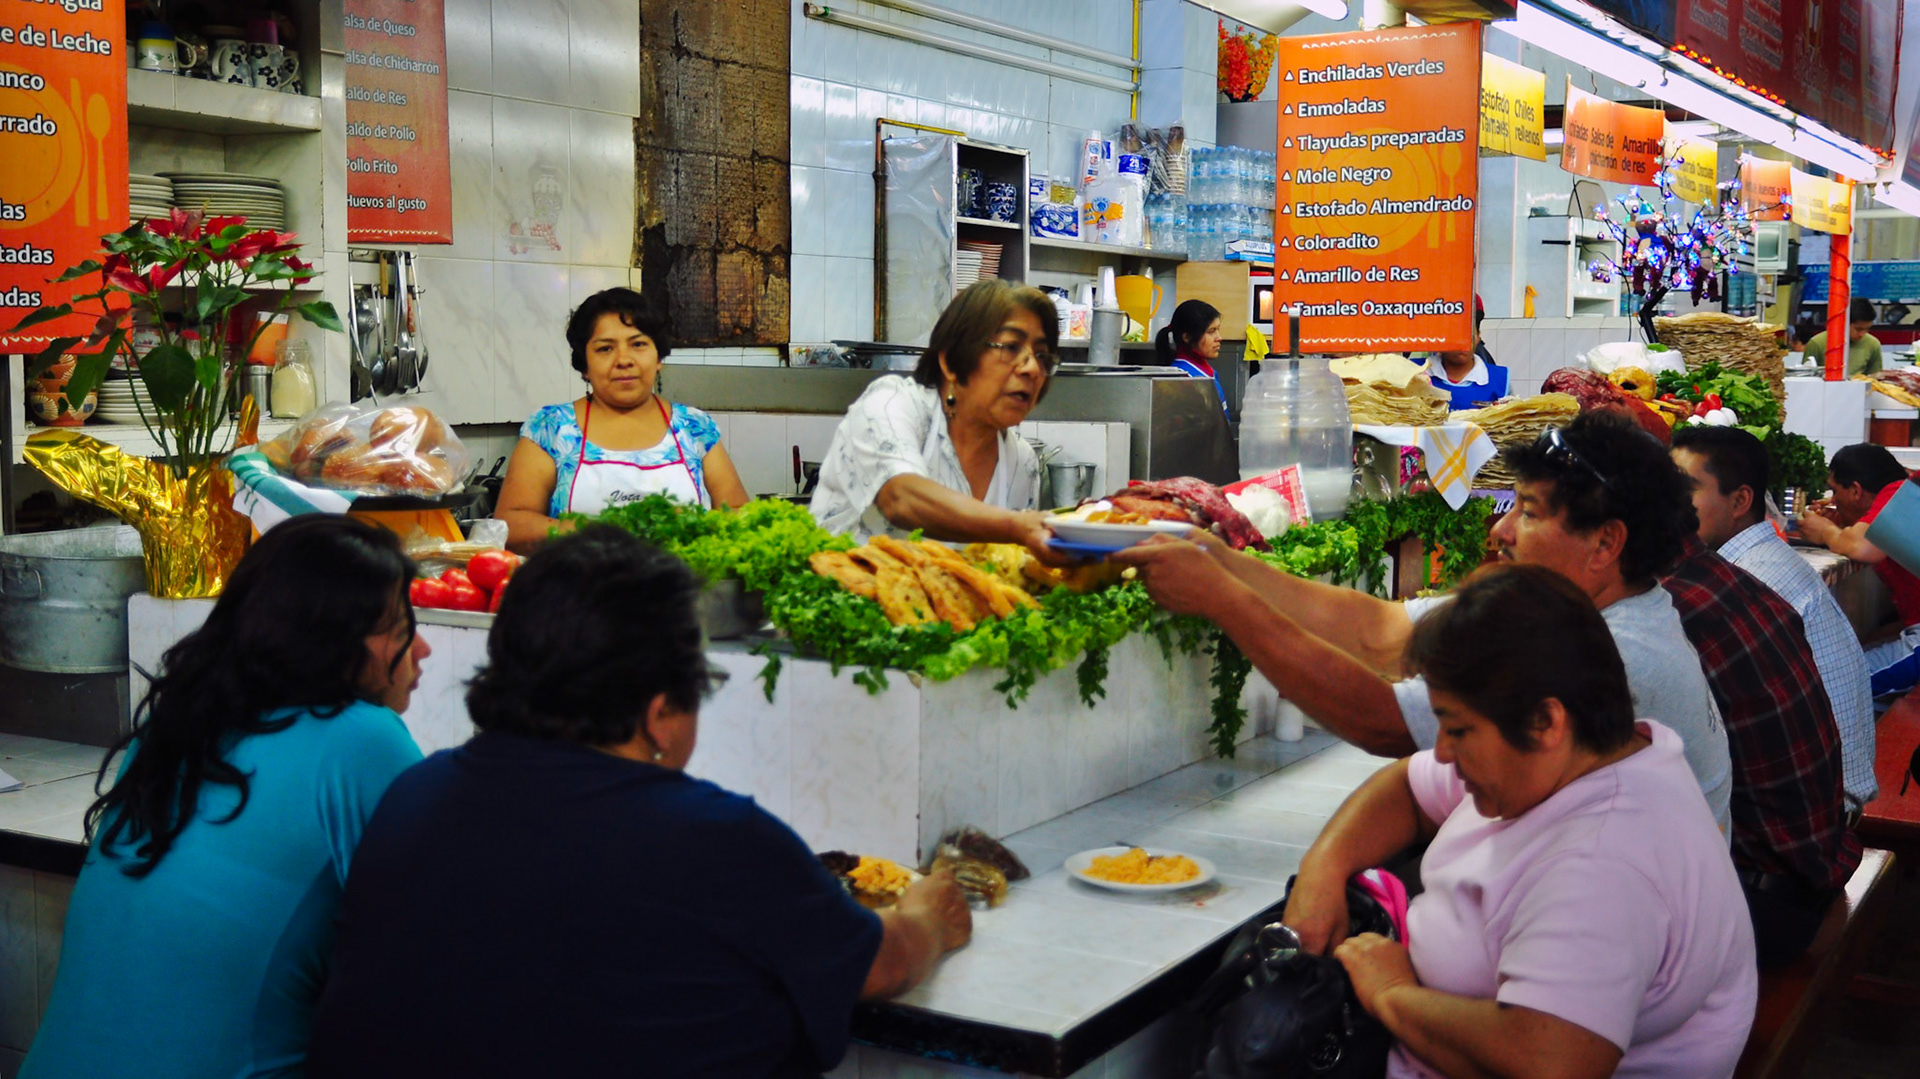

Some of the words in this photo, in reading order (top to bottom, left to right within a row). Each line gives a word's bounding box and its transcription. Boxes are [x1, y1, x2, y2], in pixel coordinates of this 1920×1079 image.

[367, 16, 381, 32] de
[383, 19, 416, 37] Queso
[0, 26, 15, 43] e
[19, 23, 47, 48] de
[50, 28, 112, 55] Leche
[368, 52, 382, 67] de
[384, 54, 440, 75] Chicharrón
[1298, 64, 1384, 85] Enchiladas
[1386, 57, 1445, 79] Verdes
[345, 86, 372, 102] aldo
[373, 88, 387, 103] de
[388, 90, 407, 106] Res
[1297, 96, 1386, 118] Enmoladas
[374, 123, 388, 139] de
[389, 125, 417, 142] Pollo
[1297, 131, 1369, 154] Tlayudas
[1370, 125, 1466, 151] preparadas
[1621, 135, 1664, 156] Amarillo
[372, 159, 399, 175] Frito
[1129, 157, 1141, 168] 25
[1621, 156, 1631, 173] de
[1632, 159, 1647, 174] res
[1295, 166, 1338, 186] Mole
[1340, 166, 1393, 187] Negro
[0, 197, 27, 220] as
[386, 195, 396, 209] al
[397, 197, 427, 214] gusto
[1295, 199, 1368, 219] Estofado
[1369, 194, 1474, 216] Almendrado
[1294, 233, 1380, 252] Coloradito
[1293, 266, 1362, 285] Amarillo
[1364, 265, 1386, 283] de
[1388, 265, 1420, 283] Res
[1293, 300, 1358, 318] Tamales
[1360, 298, 1464, 319] Oaxaqueños
[610, 490, 641, 503] Vota
